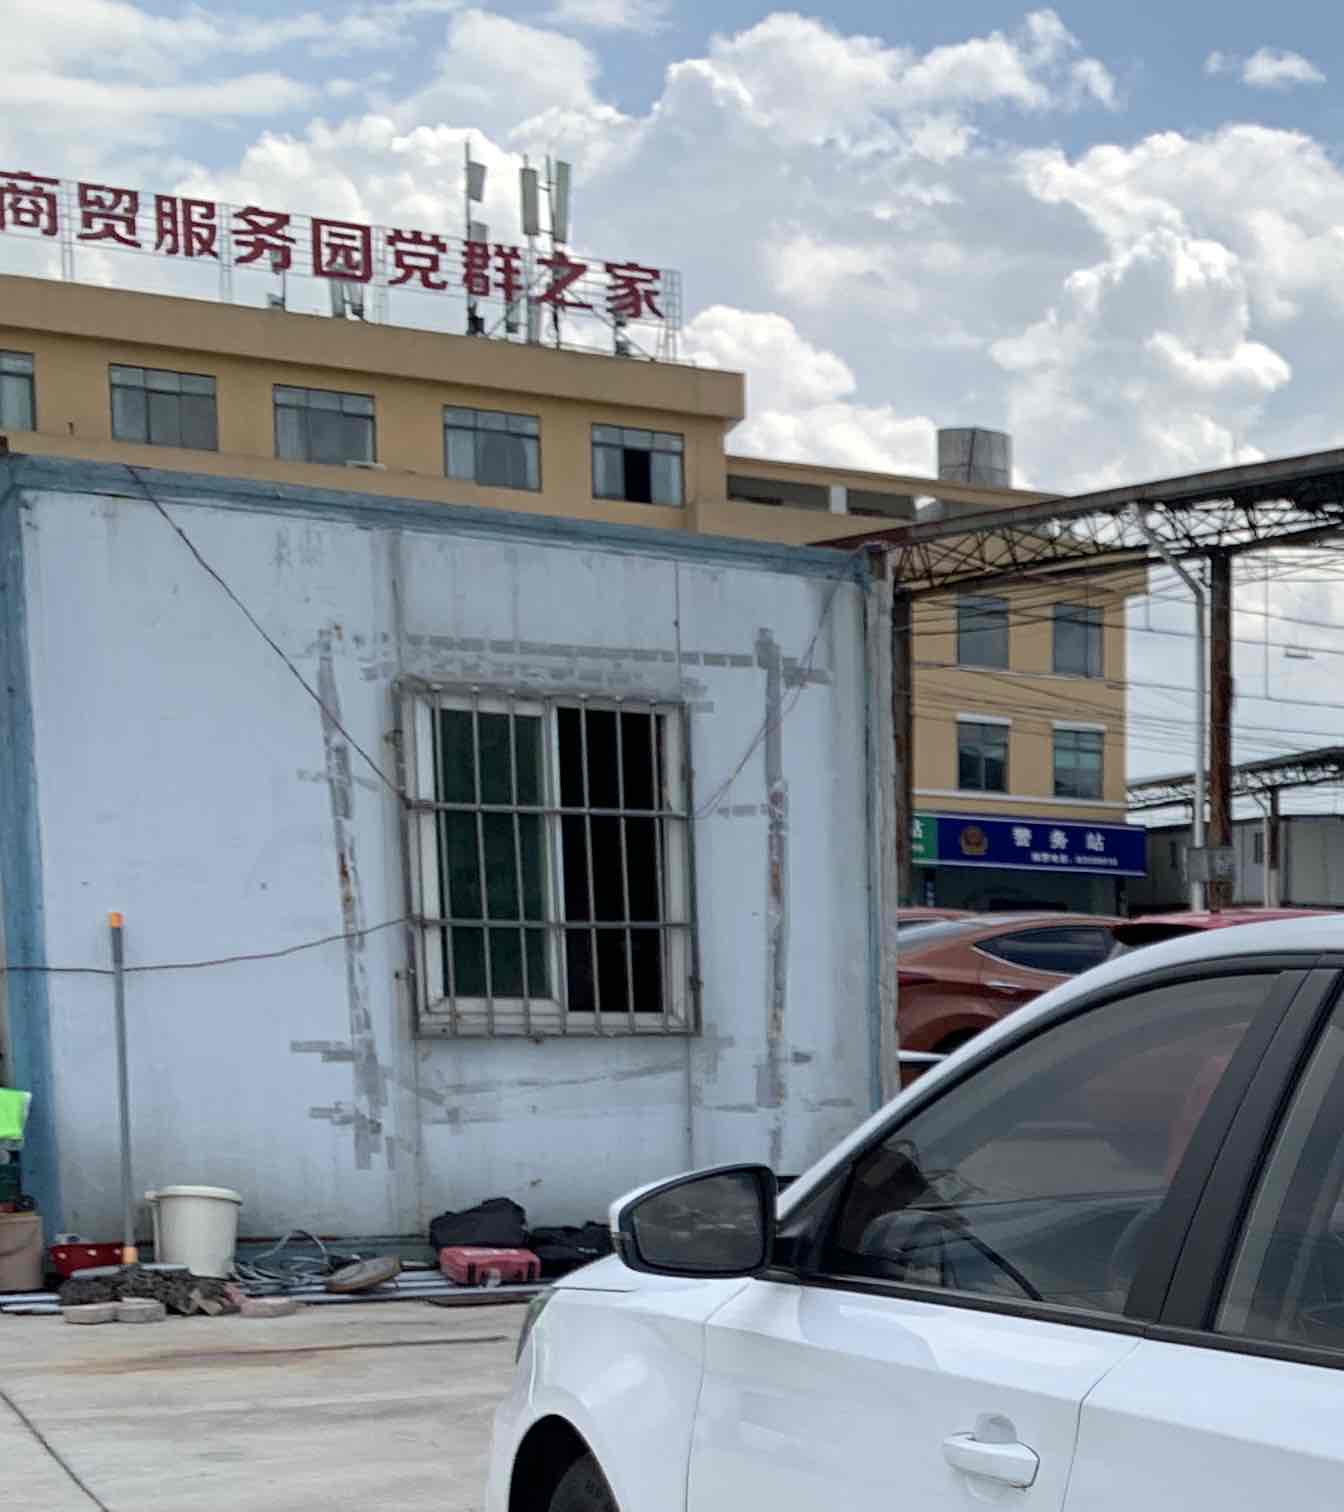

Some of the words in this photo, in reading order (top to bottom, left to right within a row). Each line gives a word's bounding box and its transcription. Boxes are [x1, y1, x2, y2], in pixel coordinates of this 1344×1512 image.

[0, 170, 665, 320] 商贸服务园党群之家
